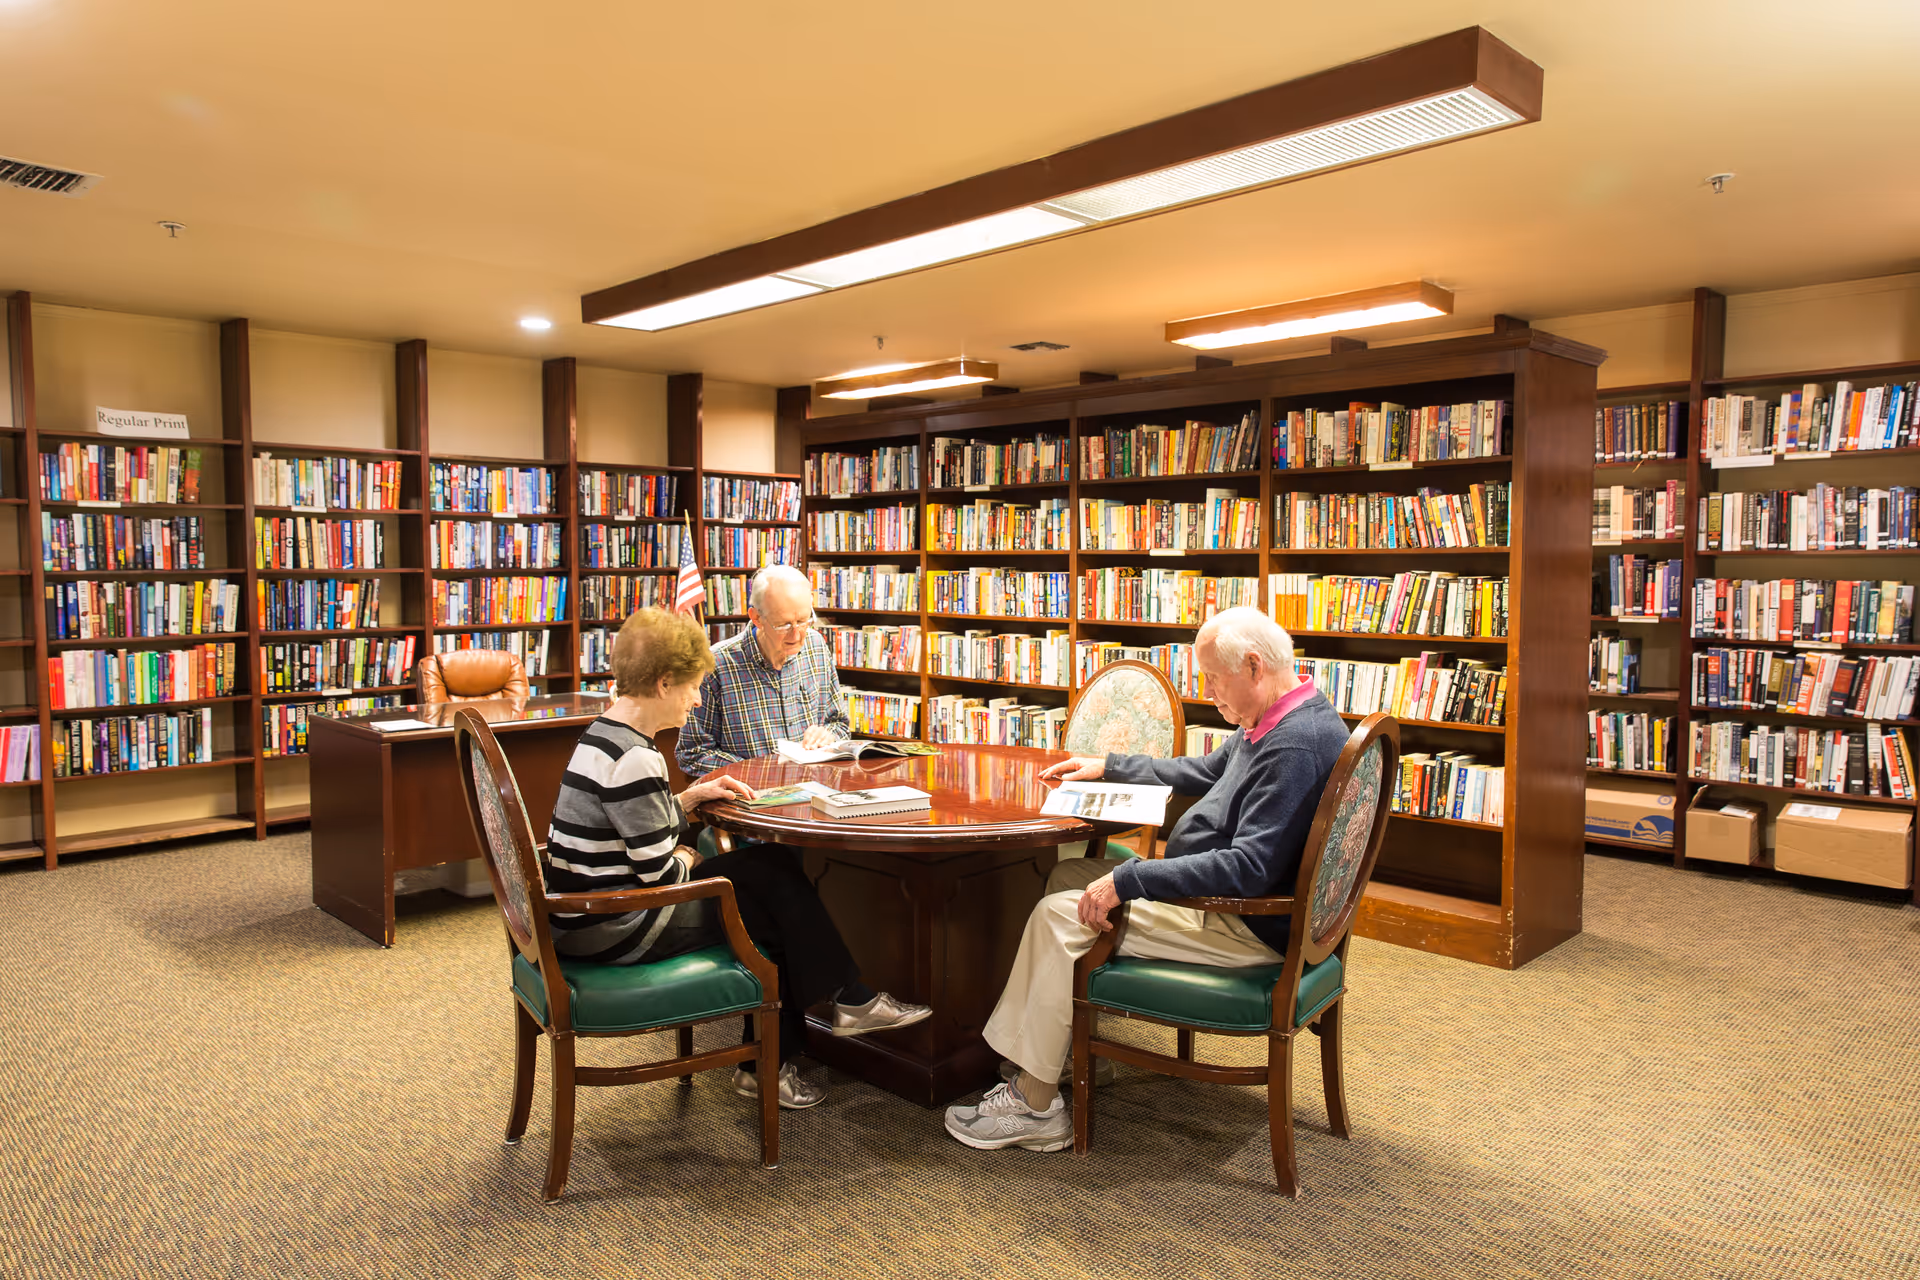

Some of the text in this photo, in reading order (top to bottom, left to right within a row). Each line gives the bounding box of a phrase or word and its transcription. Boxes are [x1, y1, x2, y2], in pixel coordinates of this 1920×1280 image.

[98, 410, 186, 429] Regular Print
[1797, 675, 1813, 703] BERLIN
